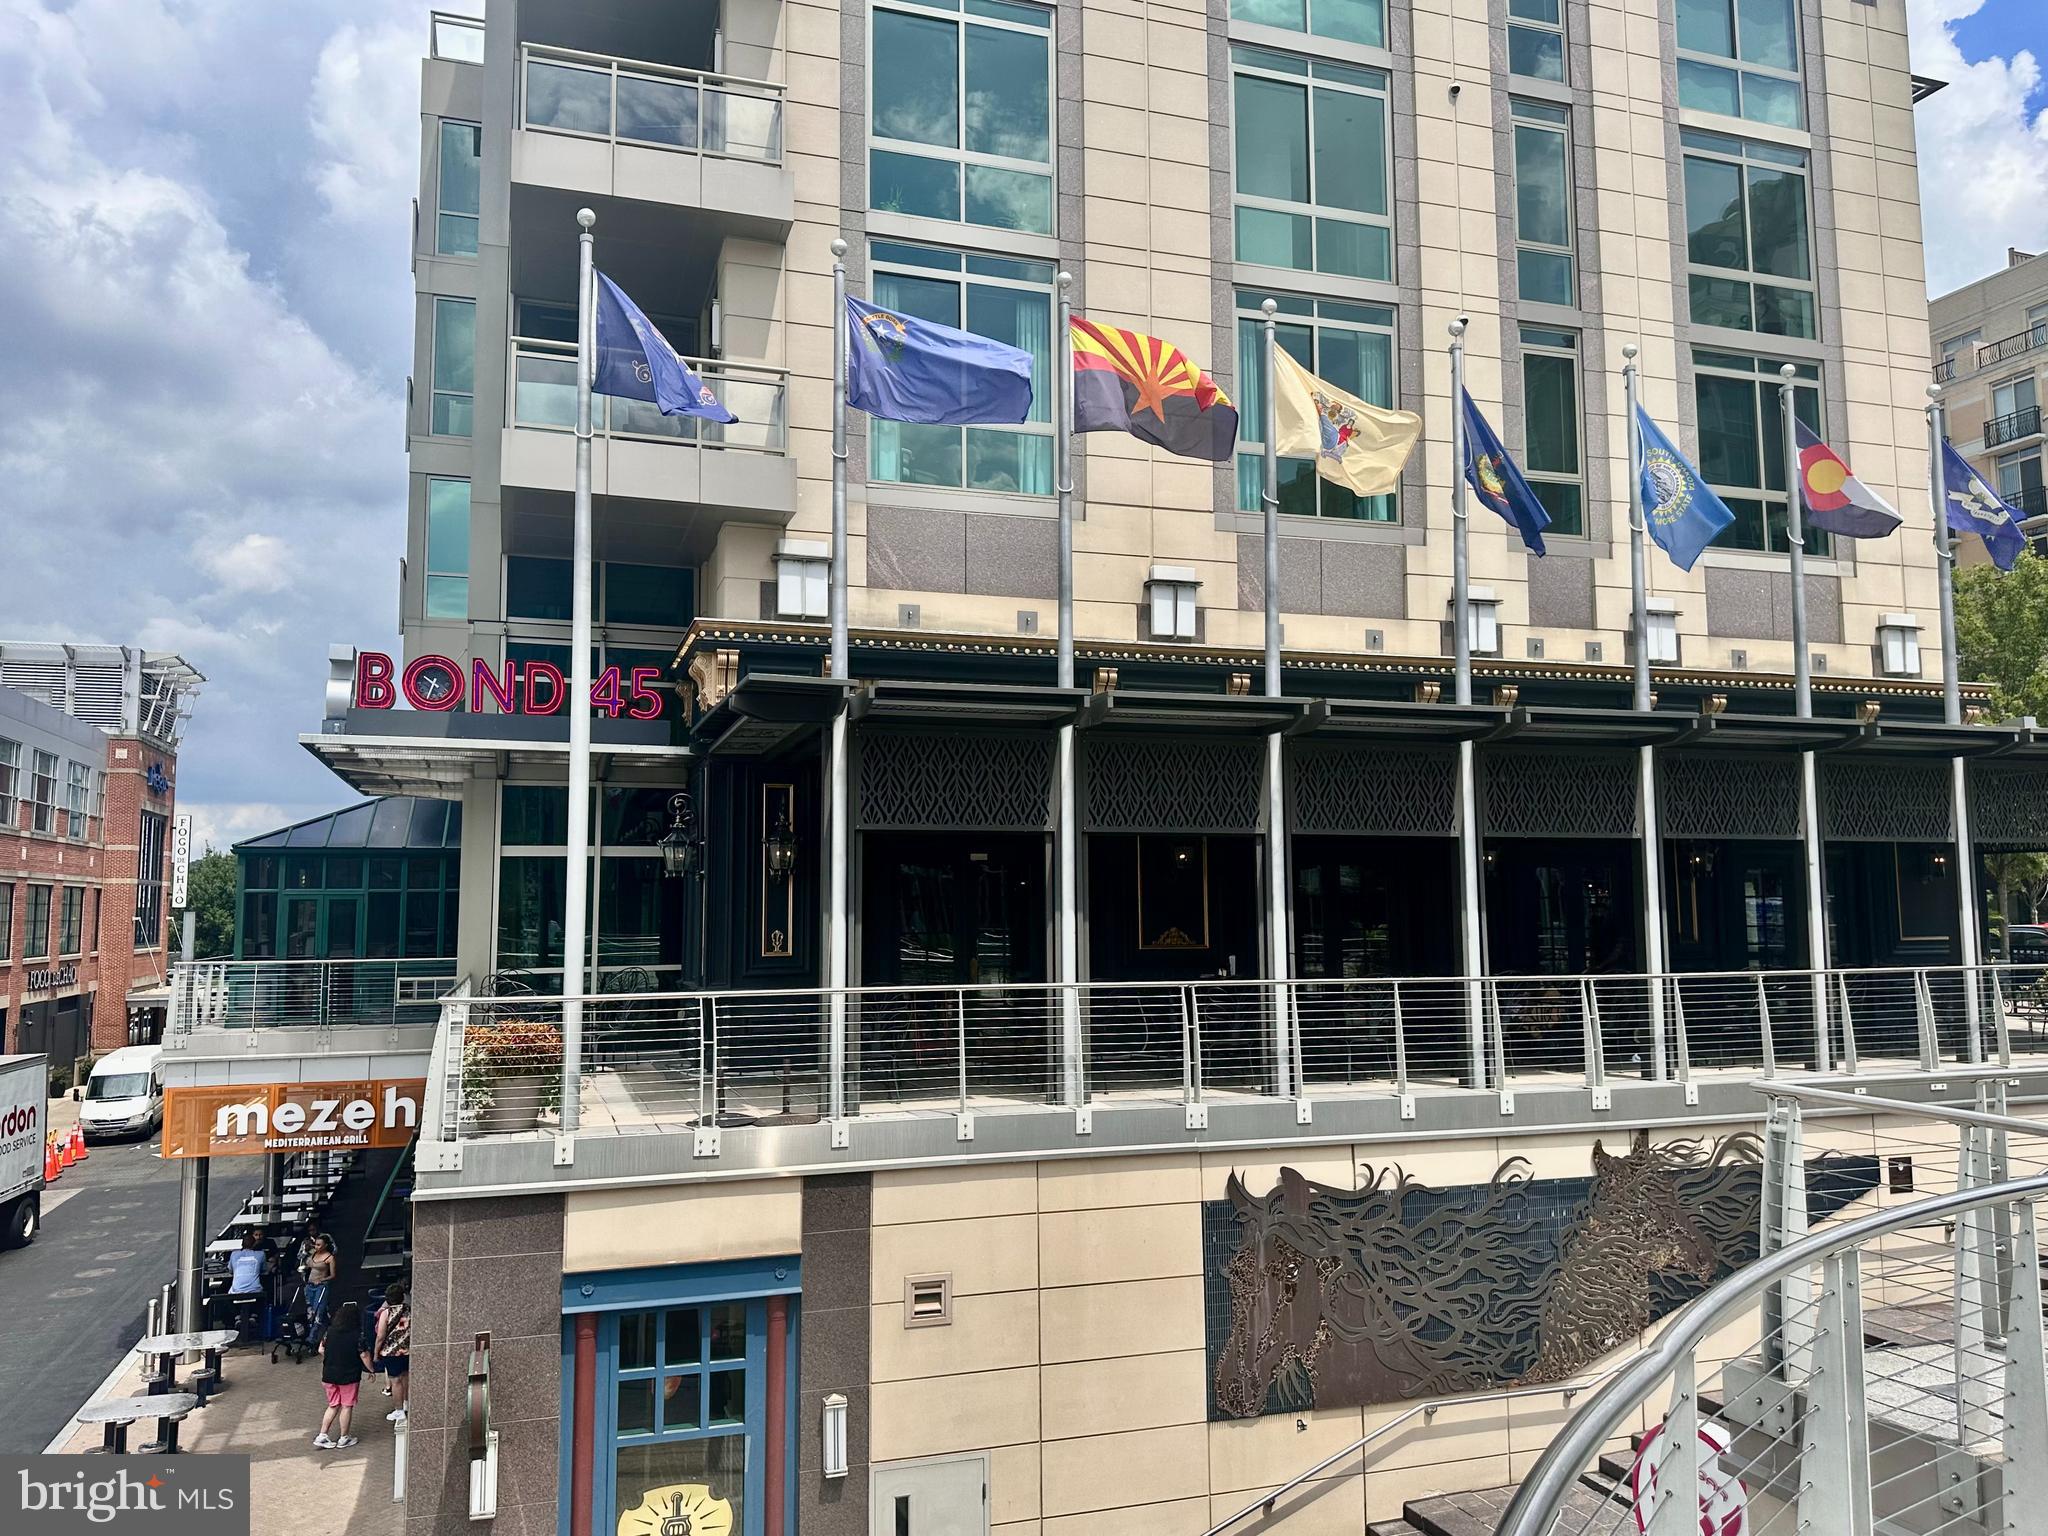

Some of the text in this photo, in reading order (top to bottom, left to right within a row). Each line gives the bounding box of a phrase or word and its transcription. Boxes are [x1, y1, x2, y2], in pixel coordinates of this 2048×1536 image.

[1676, 493, 1693, 517] STATE
[357, 651, 665, 721] BOND 45
[177, 818, 187, 856] FOGO
[30, 969, 50, 989] FOGO
[0, 1104, 36, 1139] rdon
[216, 1085, 416, 1138] mezeh
[12, 1133, 36, 1151] SERVICE
[264, 1134, 368, 1148] MEDITERRANEAN GRILL
